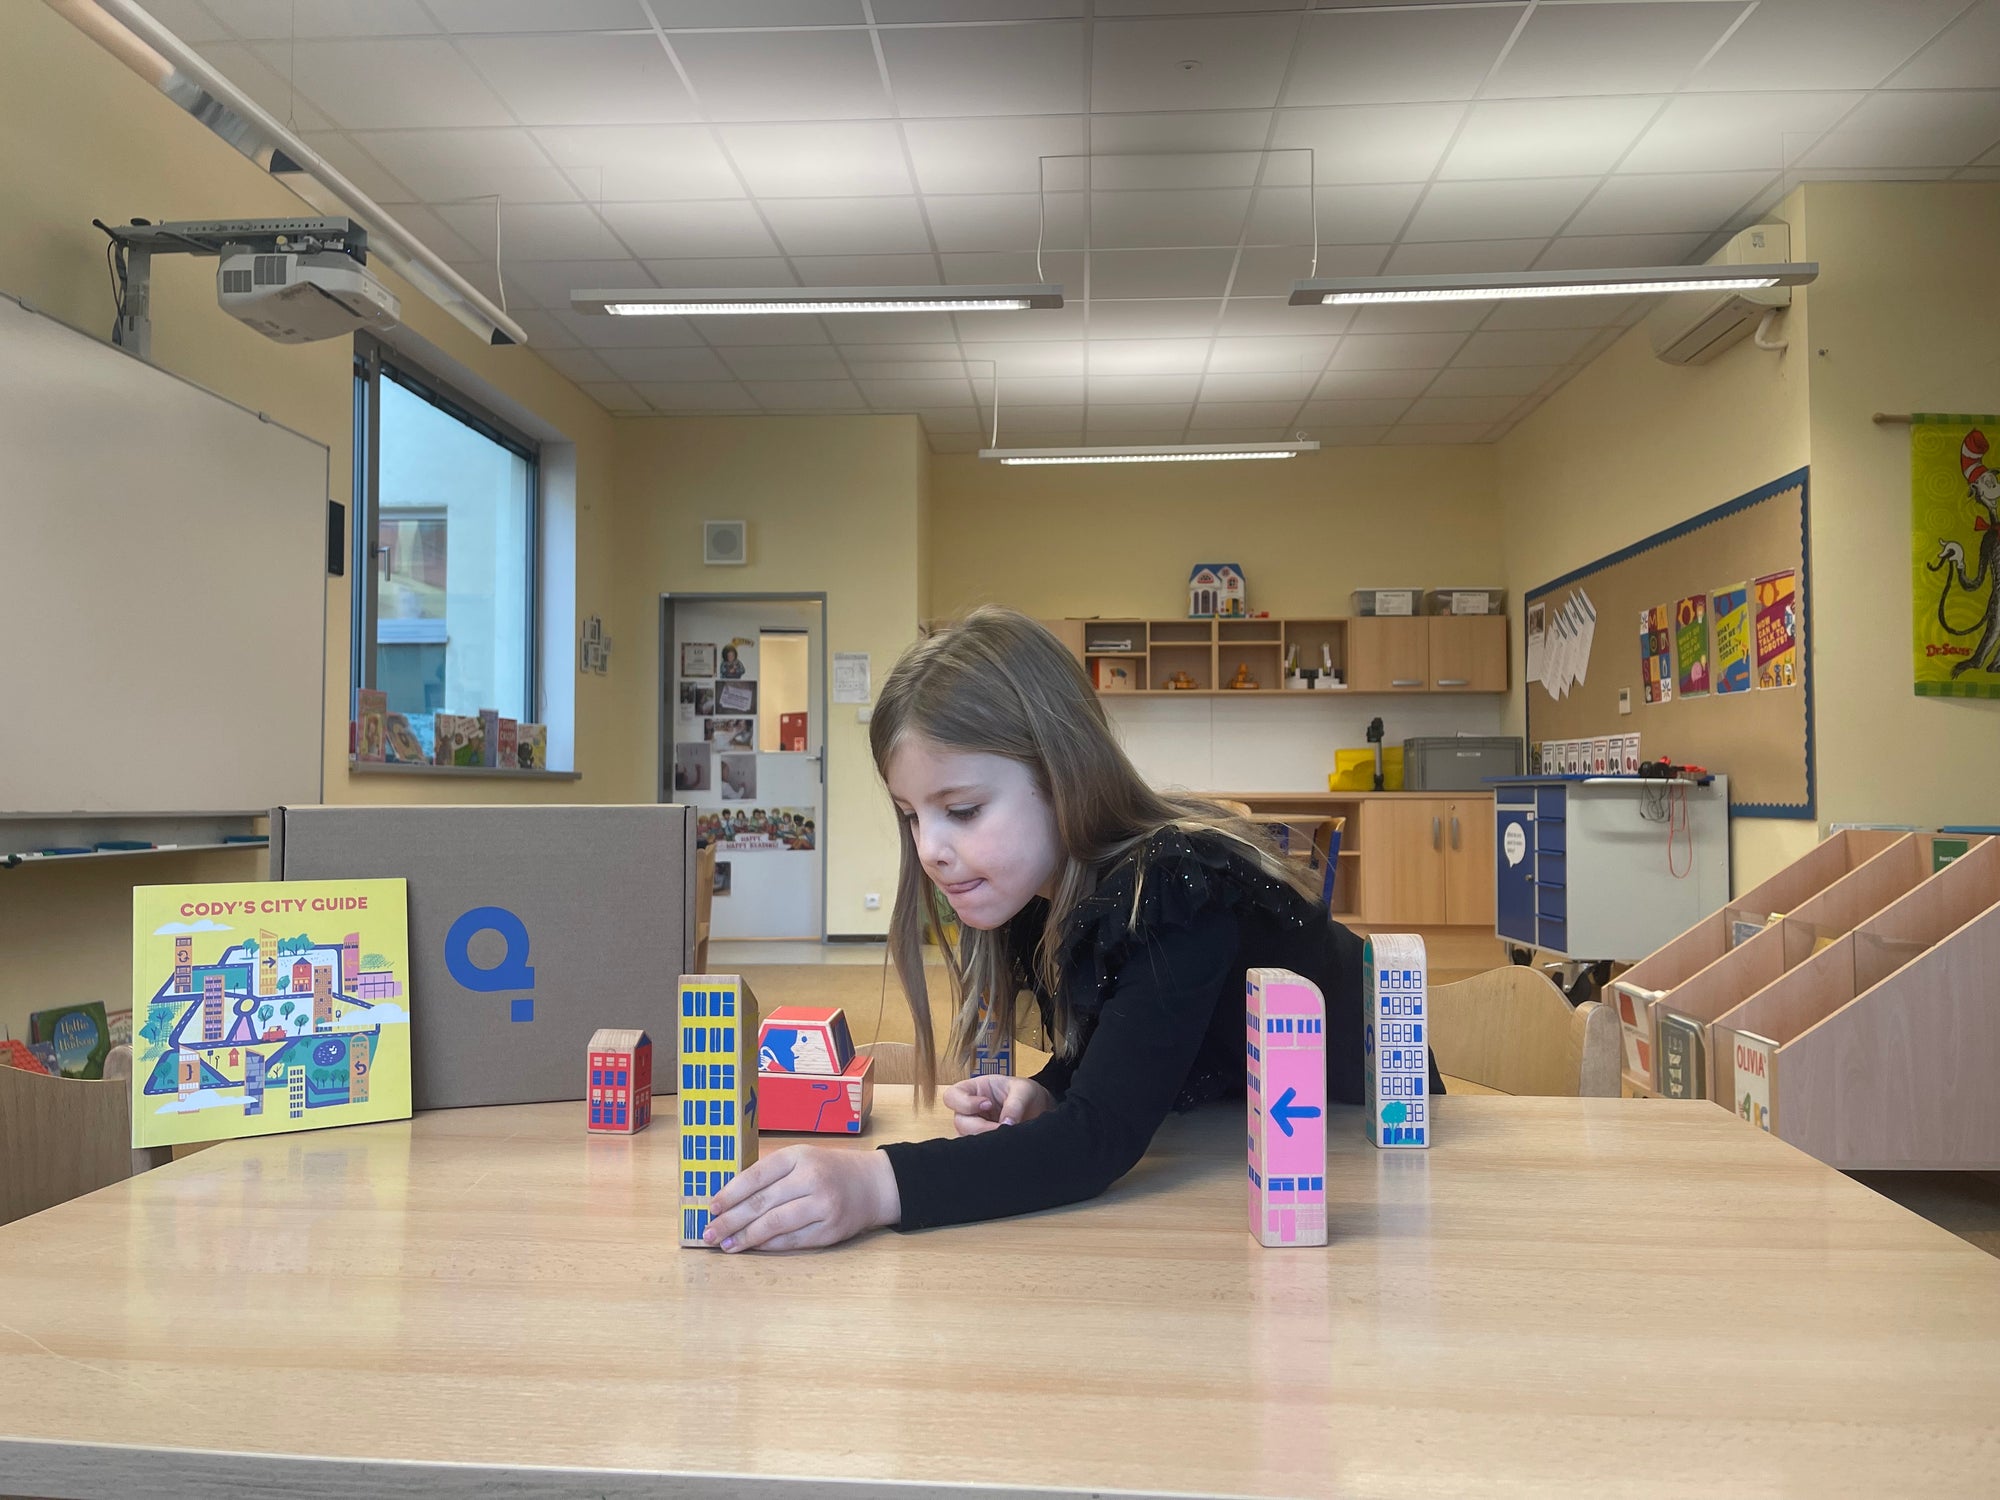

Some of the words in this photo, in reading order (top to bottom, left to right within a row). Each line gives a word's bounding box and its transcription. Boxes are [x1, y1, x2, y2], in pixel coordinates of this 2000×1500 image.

[1717, 624, 1730, 637] WHAT
[1757, 616, 1771, 630] HOW
[1758, 625, 1771, 639] CAN
[1771, 618, 1781, 630] WE
[1718, 631, 1729, 646] CAN
[1729, 628, 1736, 638] WE
[1720, 641, 1731, 654] MAKE
[1759, 632, 1775, 648] TALK
[1776, 626, 1785, 637] TO
[1760, 633, 1788, 656] ROBOTS?
[180, 900, 256, 917] CODY'S
[260, 898, 307, 913] CITY
[311, 896, 368, 911] GUIDE
[1736, 1044, 1765, 1078] OLIVIA
